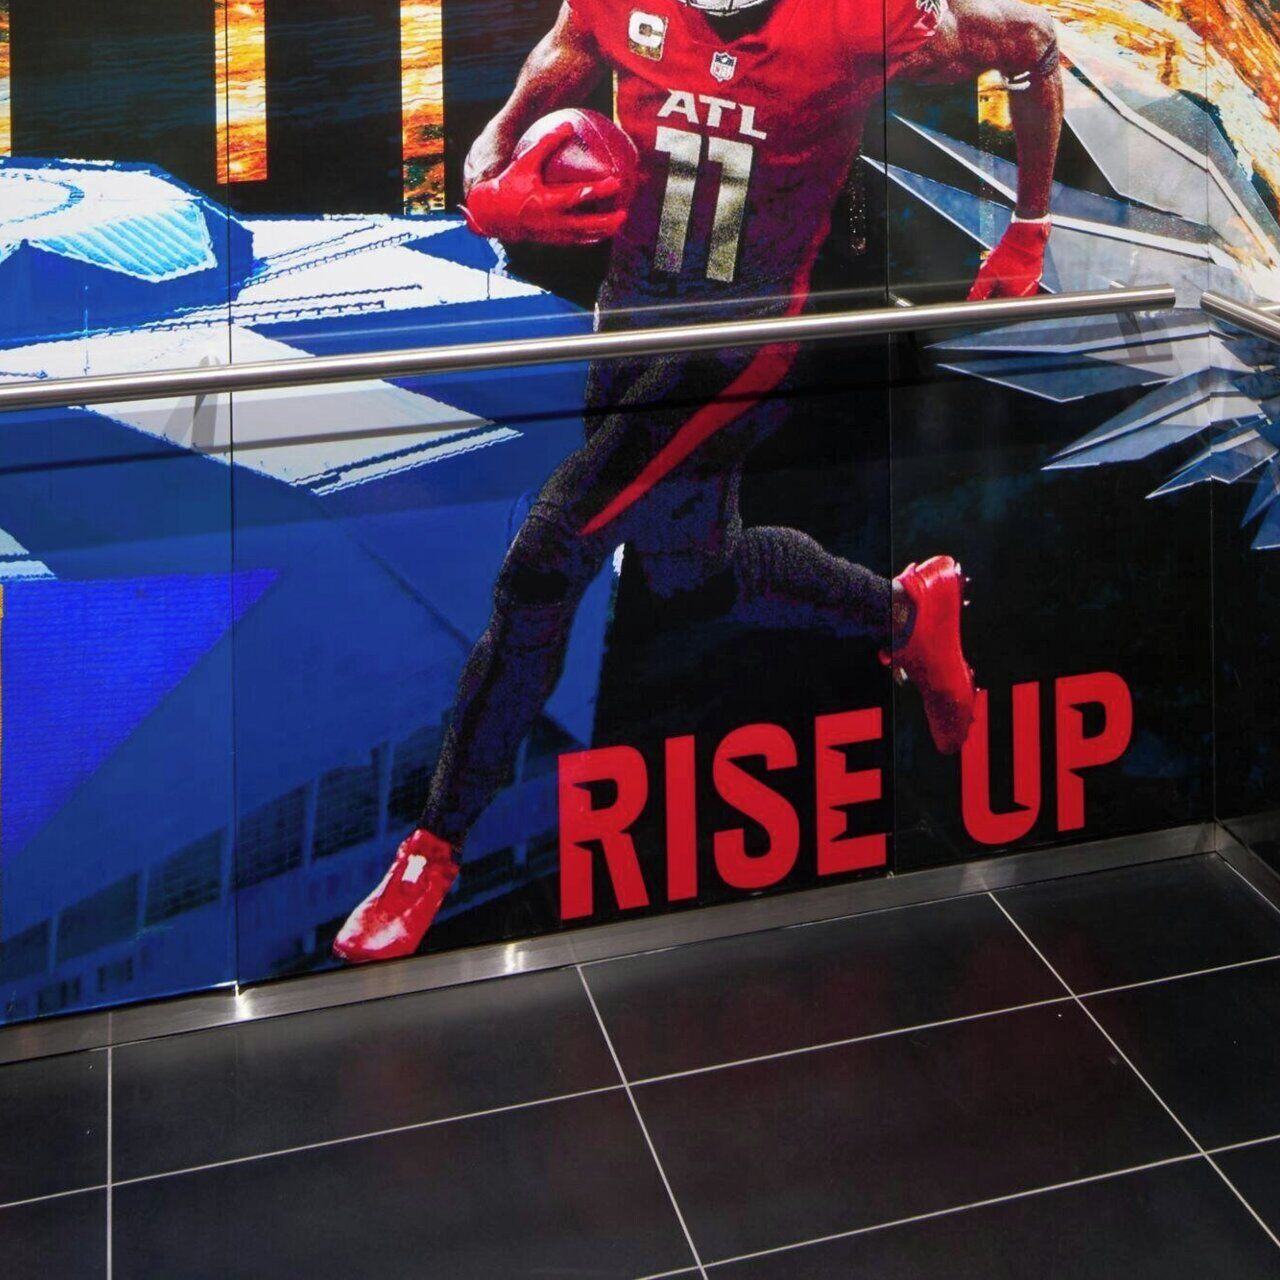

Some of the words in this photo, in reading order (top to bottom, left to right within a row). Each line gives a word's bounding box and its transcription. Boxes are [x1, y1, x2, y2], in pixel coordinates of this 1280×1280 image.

[657, 89, 767, 140] ATL
[654, 126, 753, 282] 11
[558, 707, 887, 920] RISE
[961, 671, 1133, 845] UP
